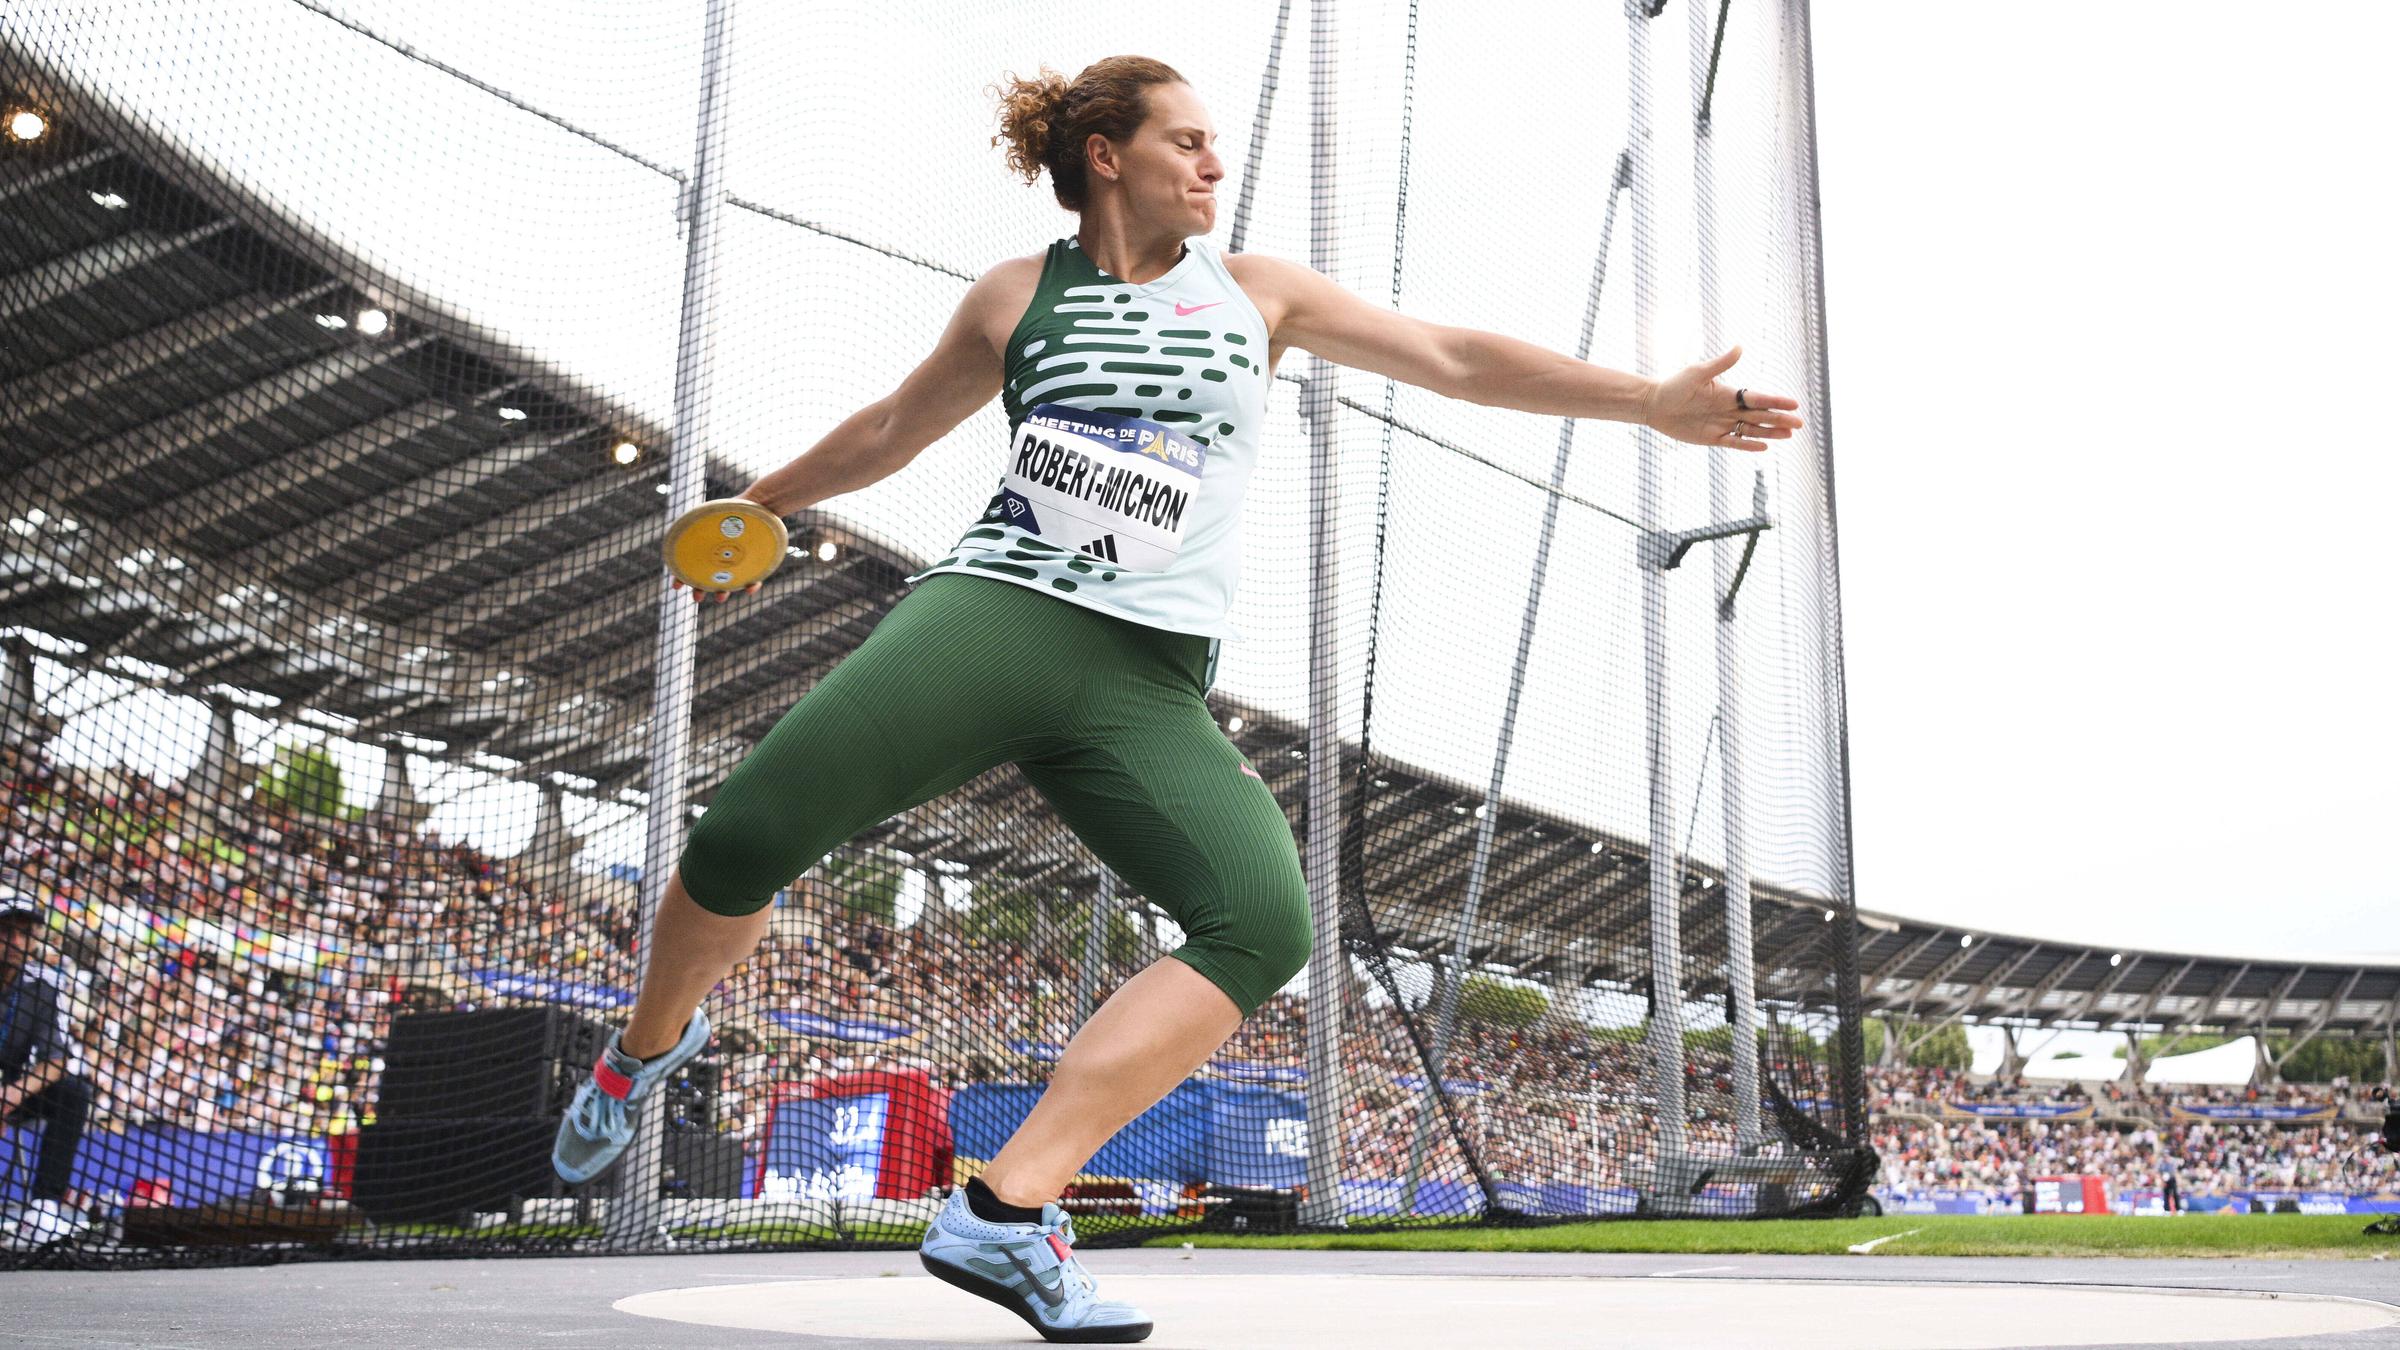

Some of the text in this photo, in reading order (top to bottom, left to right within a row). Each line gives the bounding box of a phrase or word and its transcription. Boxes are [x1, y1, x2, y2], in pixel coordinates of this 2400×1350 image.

[1030, 415, 1199, 468] MEETING DE PARIS
[1015, 433, 1188, 533] ROBERT-MICHON
